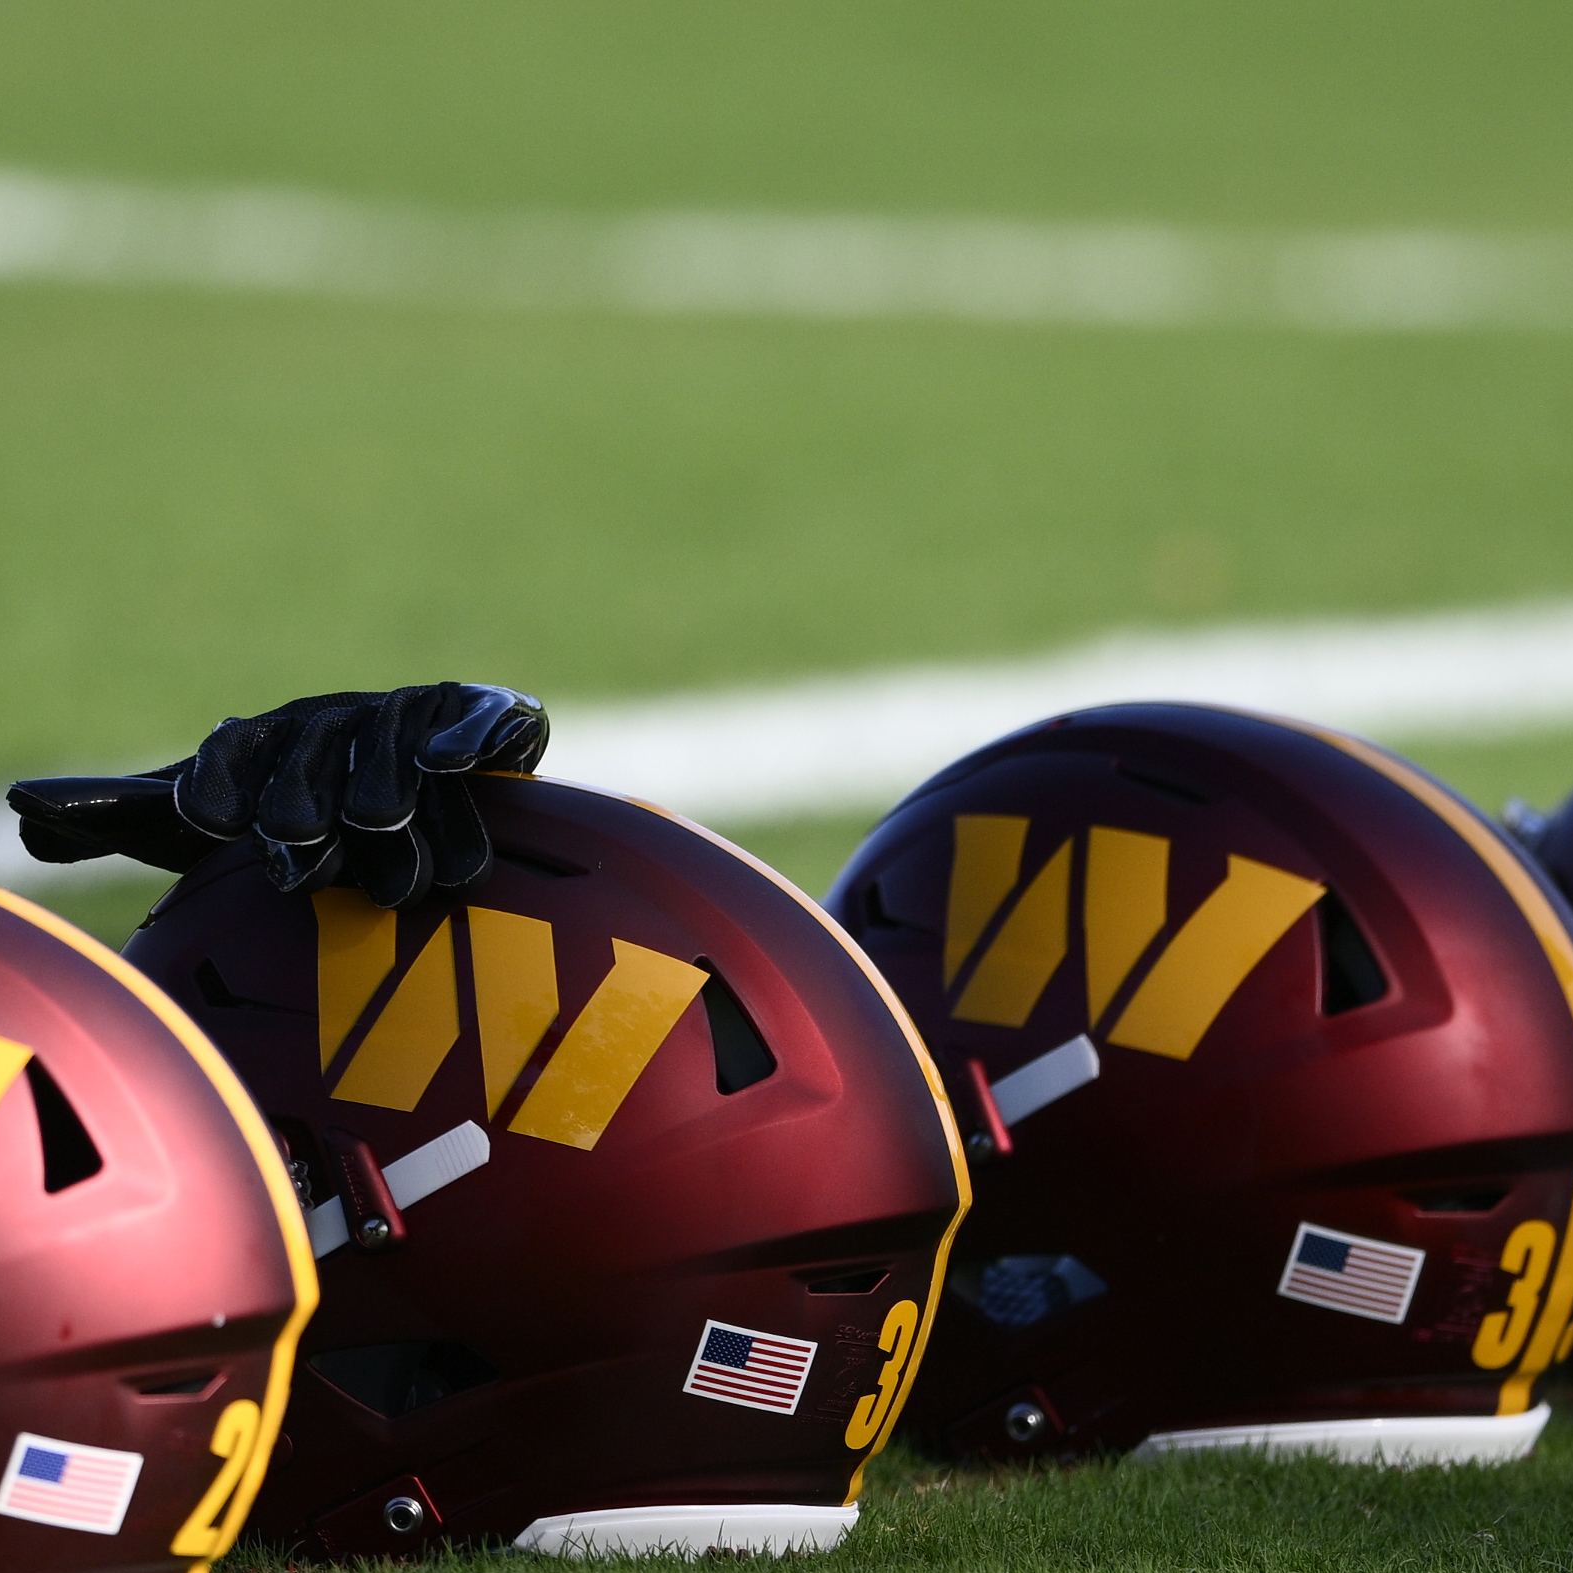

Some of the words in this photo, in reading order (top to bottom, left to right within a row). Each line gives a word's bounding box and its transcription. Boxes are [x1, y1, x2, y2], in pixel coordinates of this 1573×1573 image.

[313, 889, 711, 1151] W
[944, 813, 1328, 1062] W
[845, 1300, 919, 1450] 3
[170, 1399, 259, 1556] 2
